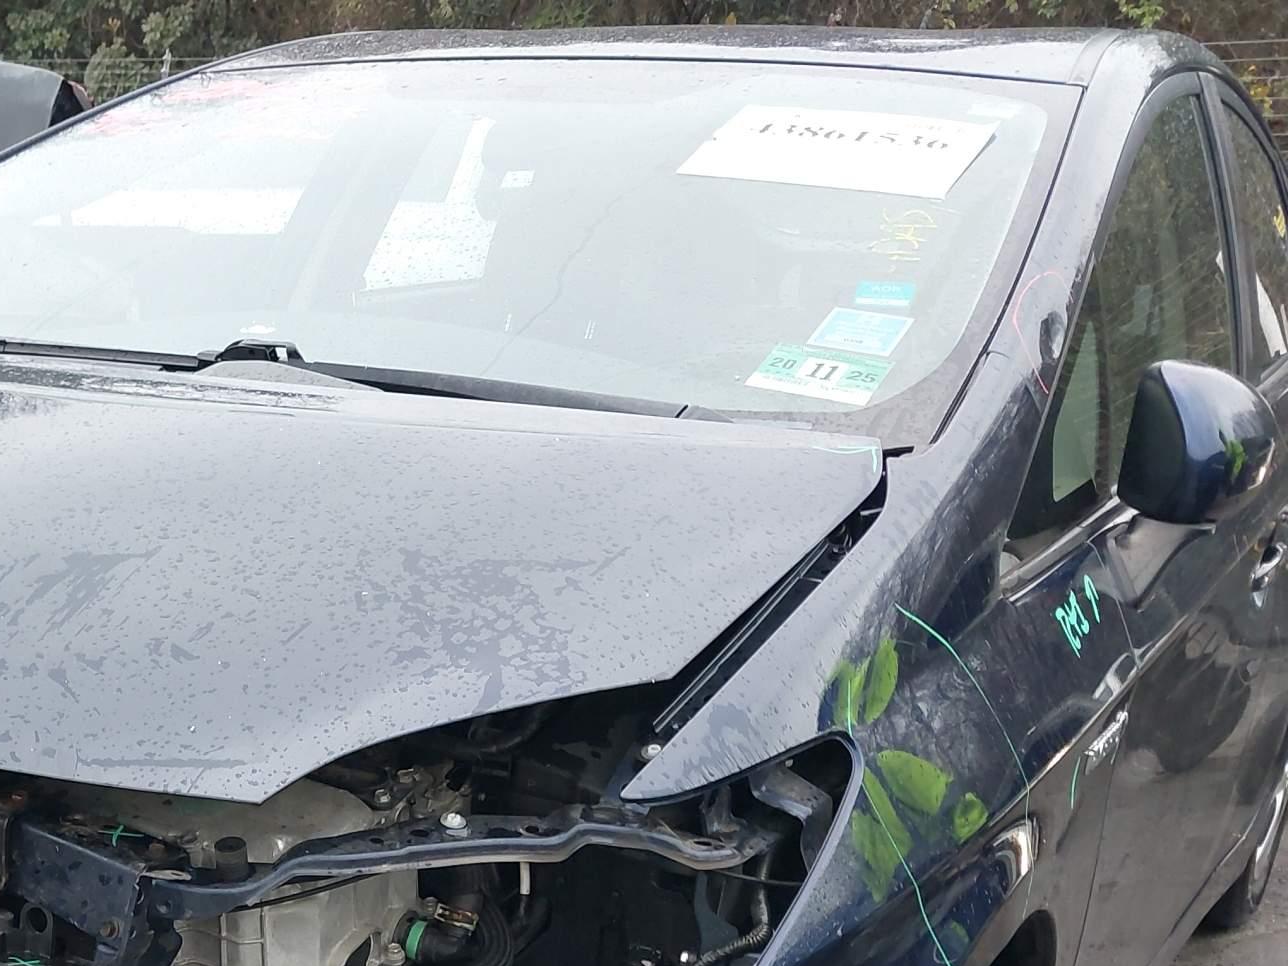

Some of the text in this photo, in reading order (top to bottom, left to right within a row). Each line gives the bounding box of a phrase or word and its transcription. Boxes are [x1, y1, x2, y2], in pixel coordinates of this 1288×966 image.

[769, 356, 798, 370] 20
[805, 362, 840, 381] 11
[845, 370, 880, 383] 25
